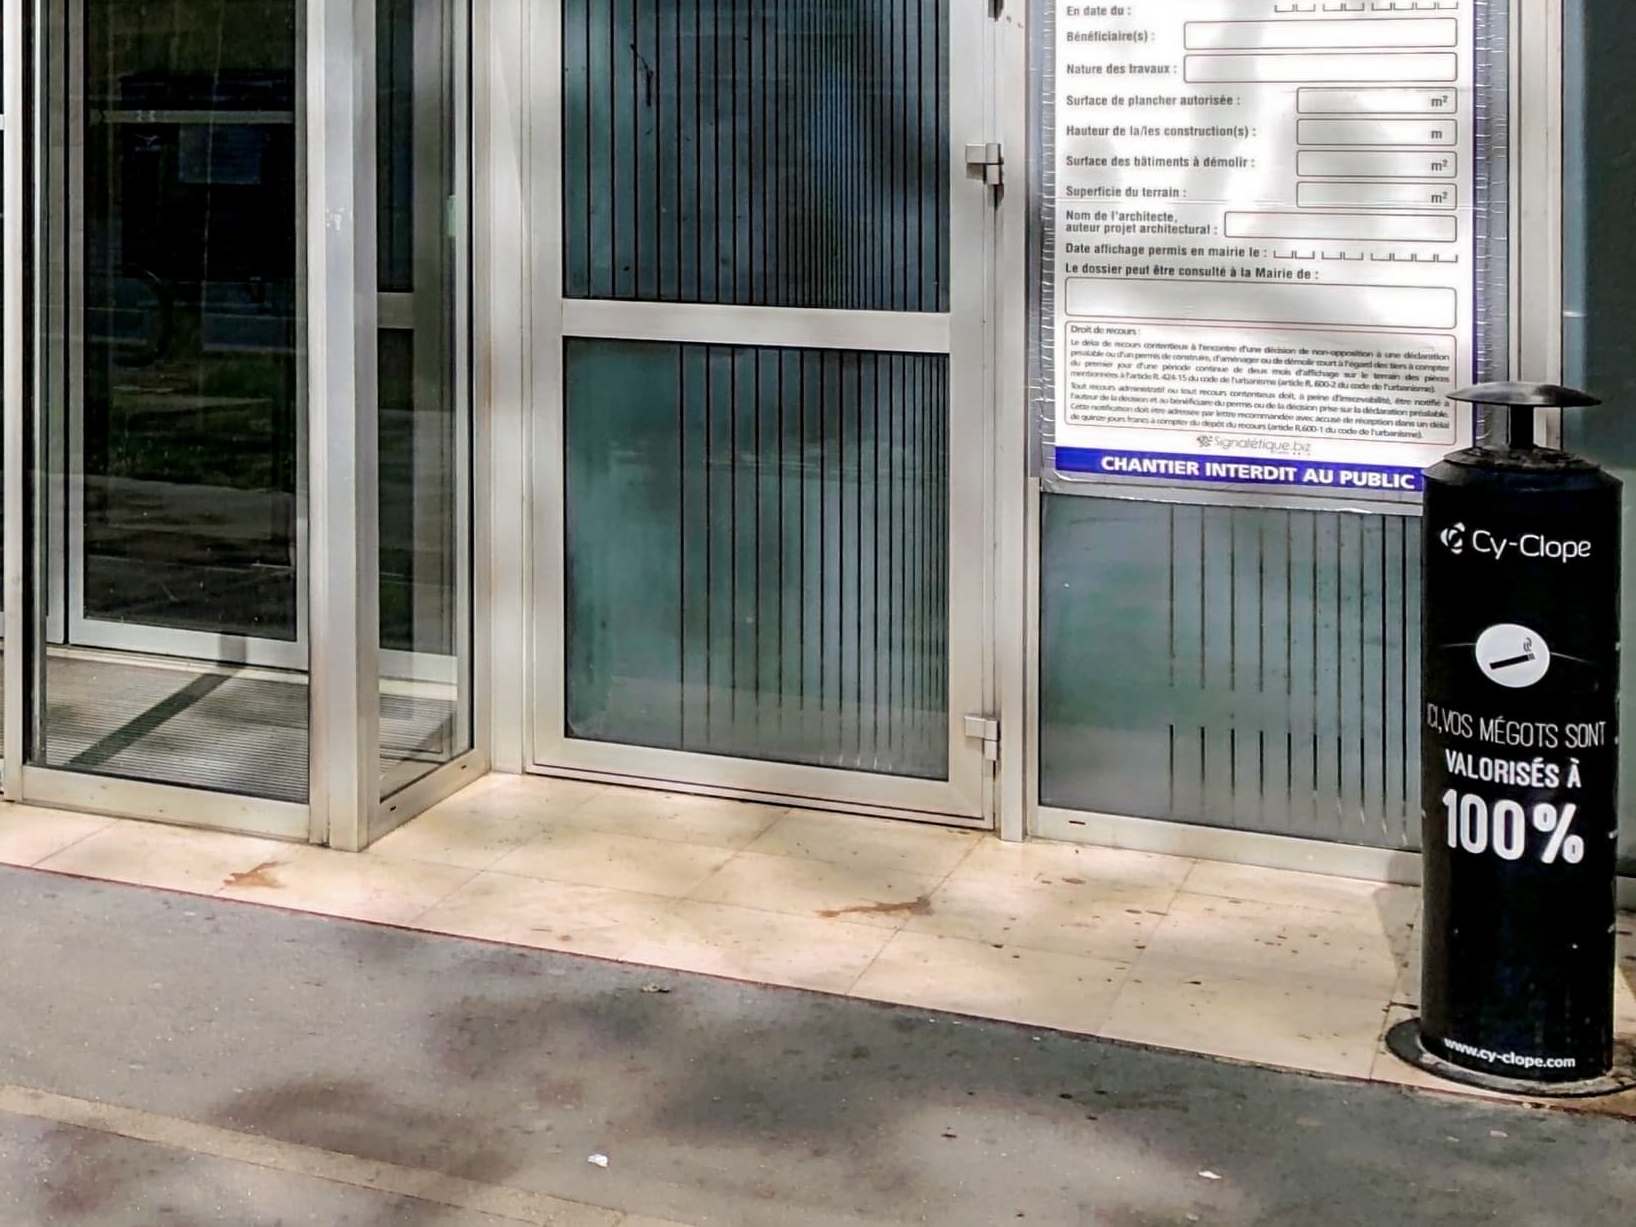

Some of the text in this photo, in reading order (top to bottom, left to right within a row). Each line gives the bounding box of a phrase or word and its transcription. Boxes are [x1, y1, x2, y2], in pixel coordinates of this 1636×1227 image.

[1067, 5, 1124, 16] En date du
[1067, 30, 1148, 43] Bénéficiaire(s)
[1067, 63, 1170, 74] Nature des travaux
[1066, 95, 1234, 108] Surface de plancher autorisée
[1066, 125, 1249, 139] Hauteur de la/les construction(s)
[1431, 130, 1442, 139] m
[1066, 155, 1248, 168] Surface des bâtiments à démolir
[1066, 186, 1179, 198] Superficie du terrain
[1066, 210, 1090, 221] Nom
[1094, 211, 1108, 221] de
[1066, 223, 1211, 235] auteur projet architectural
[1065, 243, 1260, 258] Date affichage permis en mairie le
[1065, 263, 1311, 280] Le dossier peut être consulté à la Mairie de
[1070, 324, 1092, 333] Droit
[1214, 435, 1312, 453] Signalétique.biz
[1101, 456, 1415, 489] CHANTIER INTERDIT AU PUBLIC
[1472, 530, 1591, 563] Cy-Clope
[1480, 716, 1558, 748] MÉGOTS
[1565, 721, 1606, 748] SONT
[1445, 748, 1581, 788] VALORISÉS À
[1442, 789, 1584, 864] 100%
[1444, 1038, 1576, 1068] www.cy-clope.com
